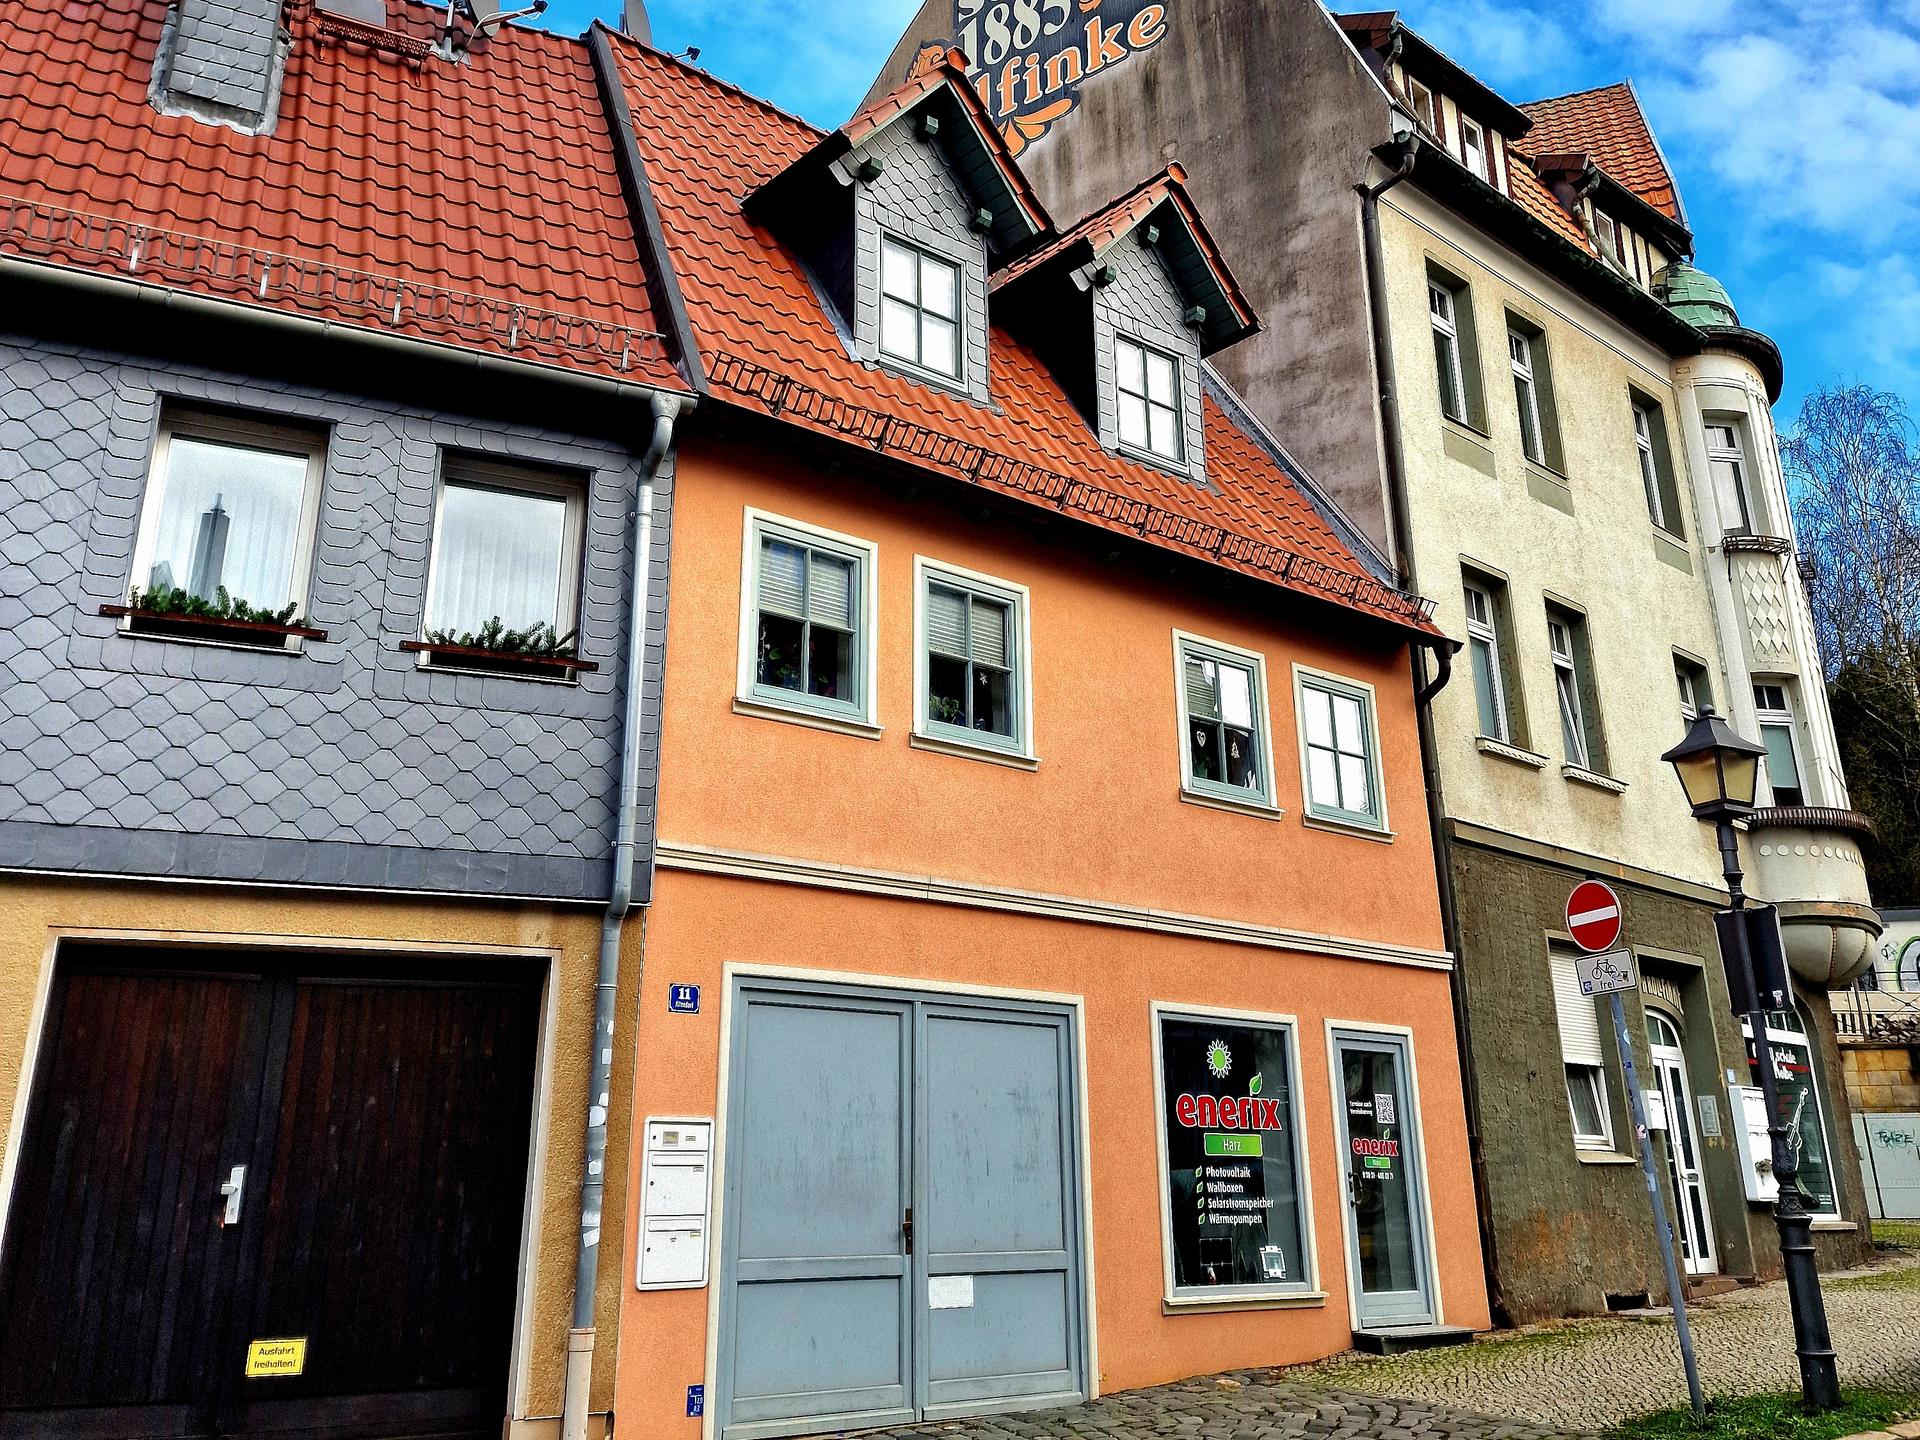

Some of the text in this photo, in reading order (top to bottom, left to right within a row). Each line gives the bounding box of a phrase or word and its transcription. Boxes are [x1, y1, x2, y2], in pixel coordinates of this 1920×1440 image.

[957, 0, 1071, 77] 1885
[678, 987, 691, 1000] 11
[1176, 1093, 1282, 1130] enerix
[1223, 1139, 1241, 1151] Harz
[1352, 1138, 1399, 1156] enerix
[1205, 1166, 1251, 1178] Photovoltaik
[1207, 1181, 1244, 1193] Wallboxen
[1208, 1196, 1275, 1211] Solarstromspeicher
[1209, 1213, 1263, 1226] Wärmepumpen
[258, 1346, 295, 1356] Ausfahrt
[254, 1359, 297, 1369] freihalten!
